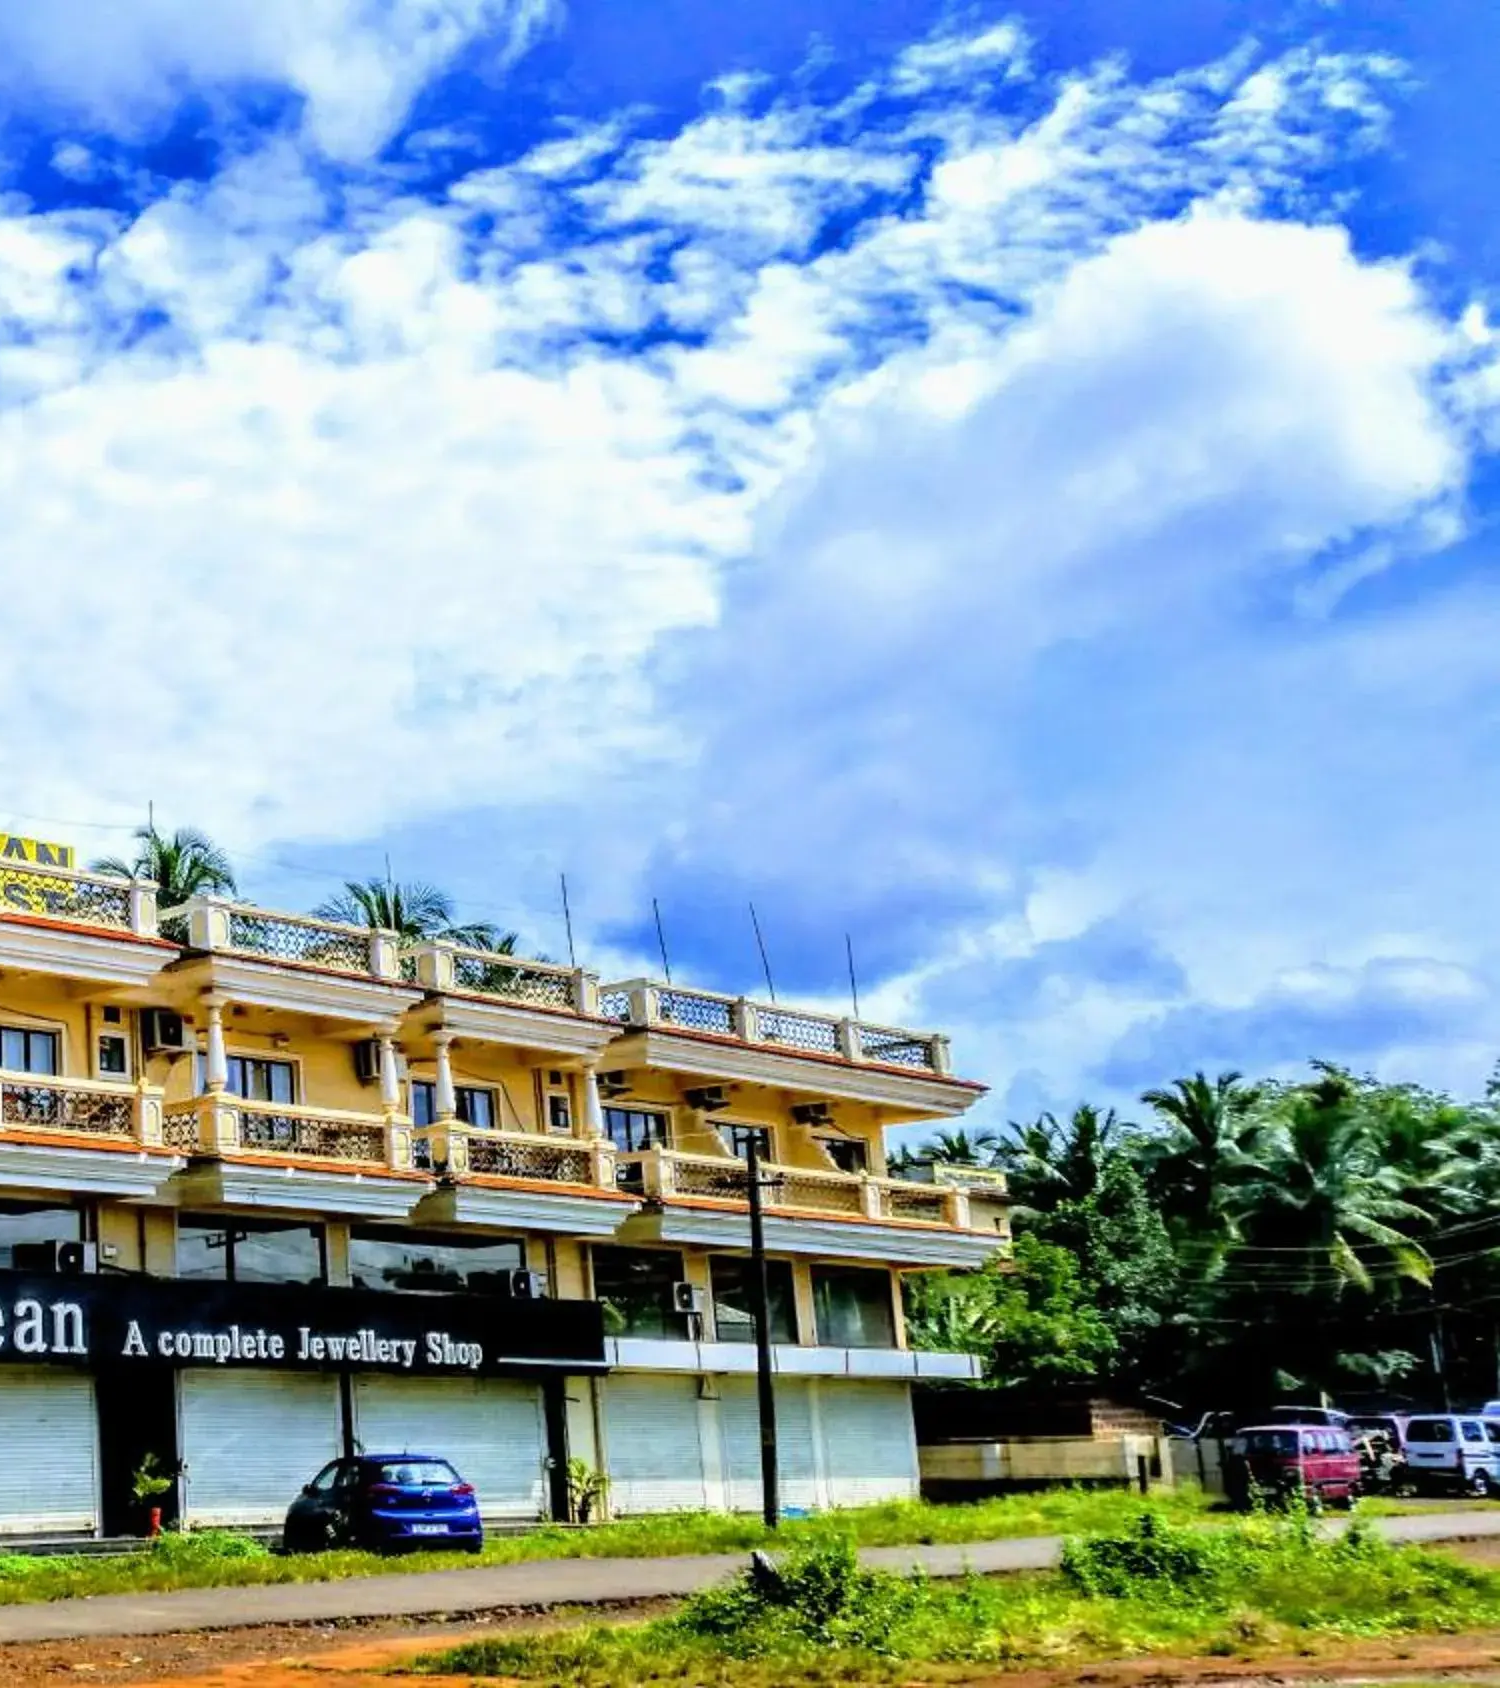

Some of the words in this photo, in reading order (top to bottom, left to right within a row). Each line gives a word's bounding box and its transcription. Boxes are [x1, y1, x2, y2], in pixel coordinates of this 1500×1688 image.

[121, 1319, 149, 1358] A
[156, 1324, 286, 1364] complete
[296, 1326, 417, 1368] Jewellery
[424, 1330, 484, 1370] Shop
